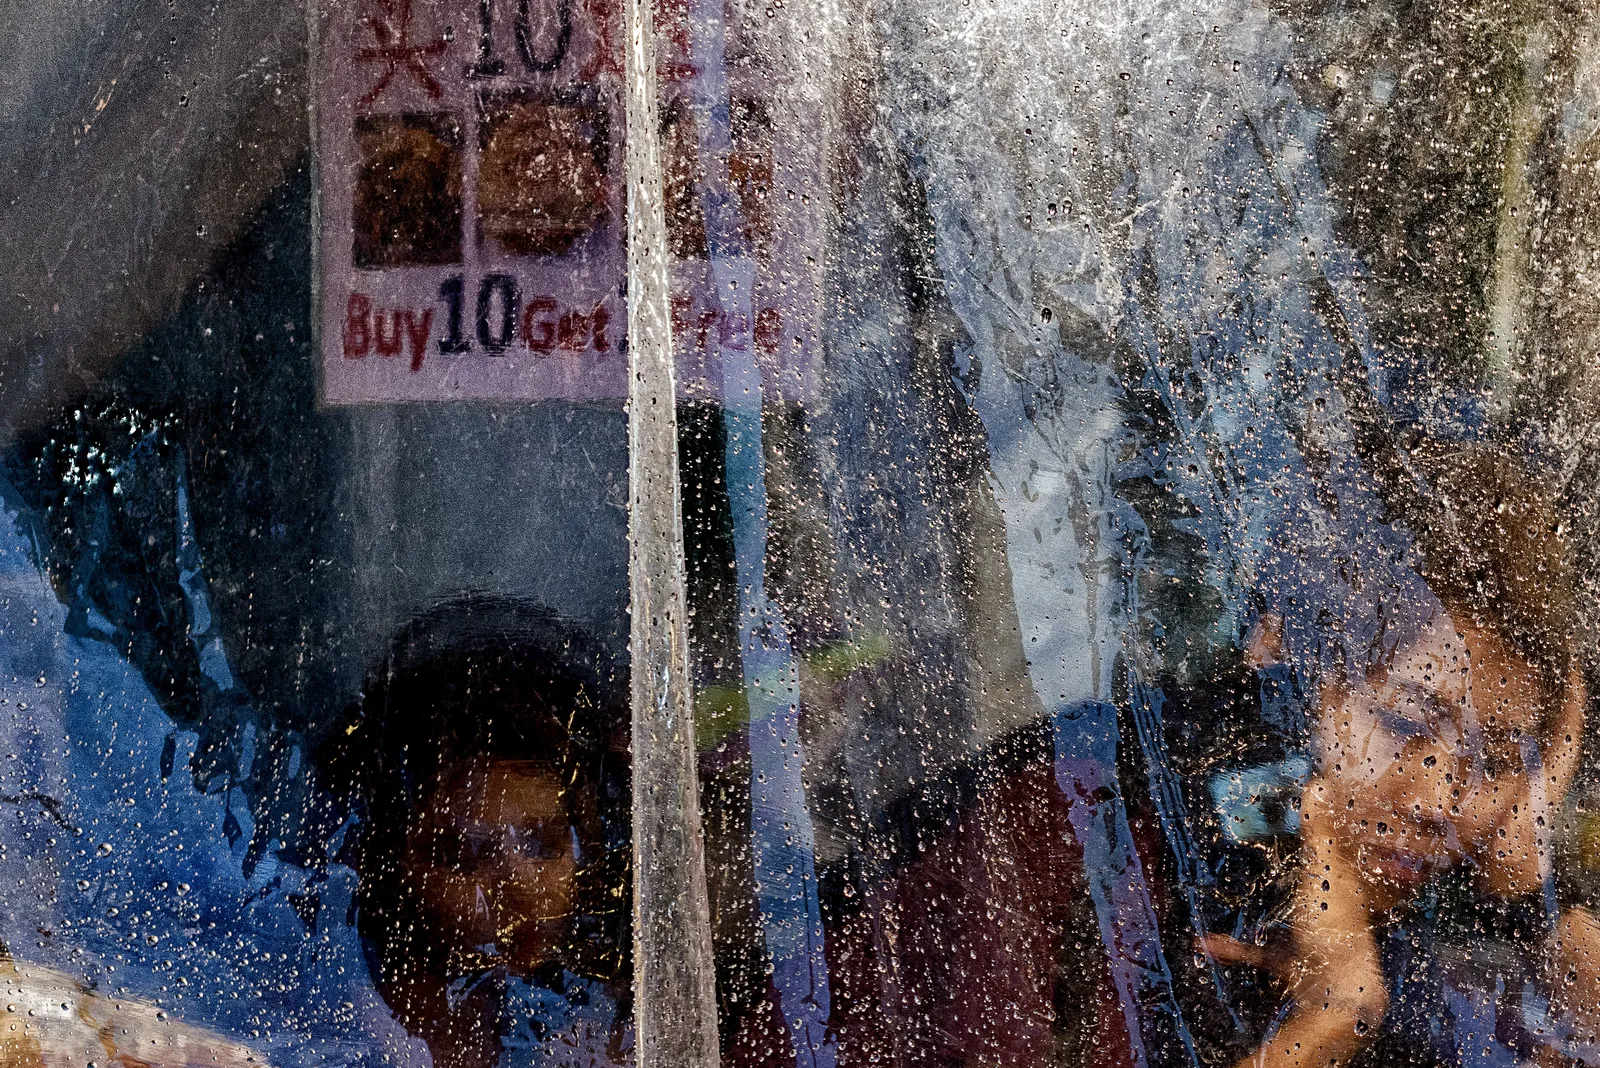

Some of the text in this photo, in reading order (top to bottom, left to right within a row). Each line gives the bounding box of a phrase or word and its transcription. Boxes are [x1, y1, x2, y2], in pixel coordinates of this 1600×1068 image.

[343, 293, 432, 372] Buy
[437, 273, 516, 357] 10
[523, 295, 612, 357] Get
[670, 295, 784, 355] Free
